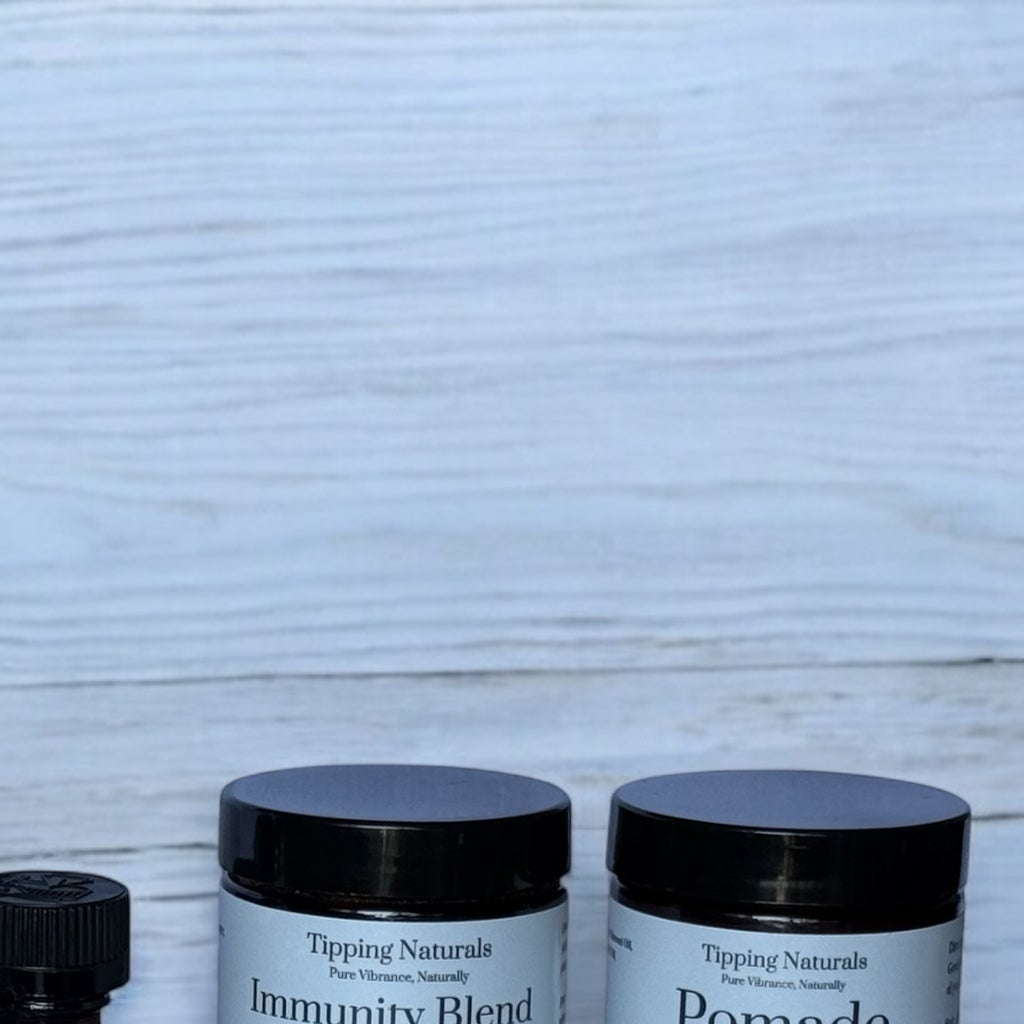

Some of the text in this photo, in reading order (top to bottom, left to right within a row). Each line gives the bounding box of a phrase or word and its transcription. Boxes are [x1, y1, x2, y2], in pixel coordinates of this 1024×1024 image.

[307, 932, 492, 965] Tipping Naturals
[702, 943, 868, 973] Tipping Naturals
[329, 966, 470, 984] Pure Vibrance, Naturally
[721, 974, 745, 986] Pure
[798, 979, 847, 992] Naturally
